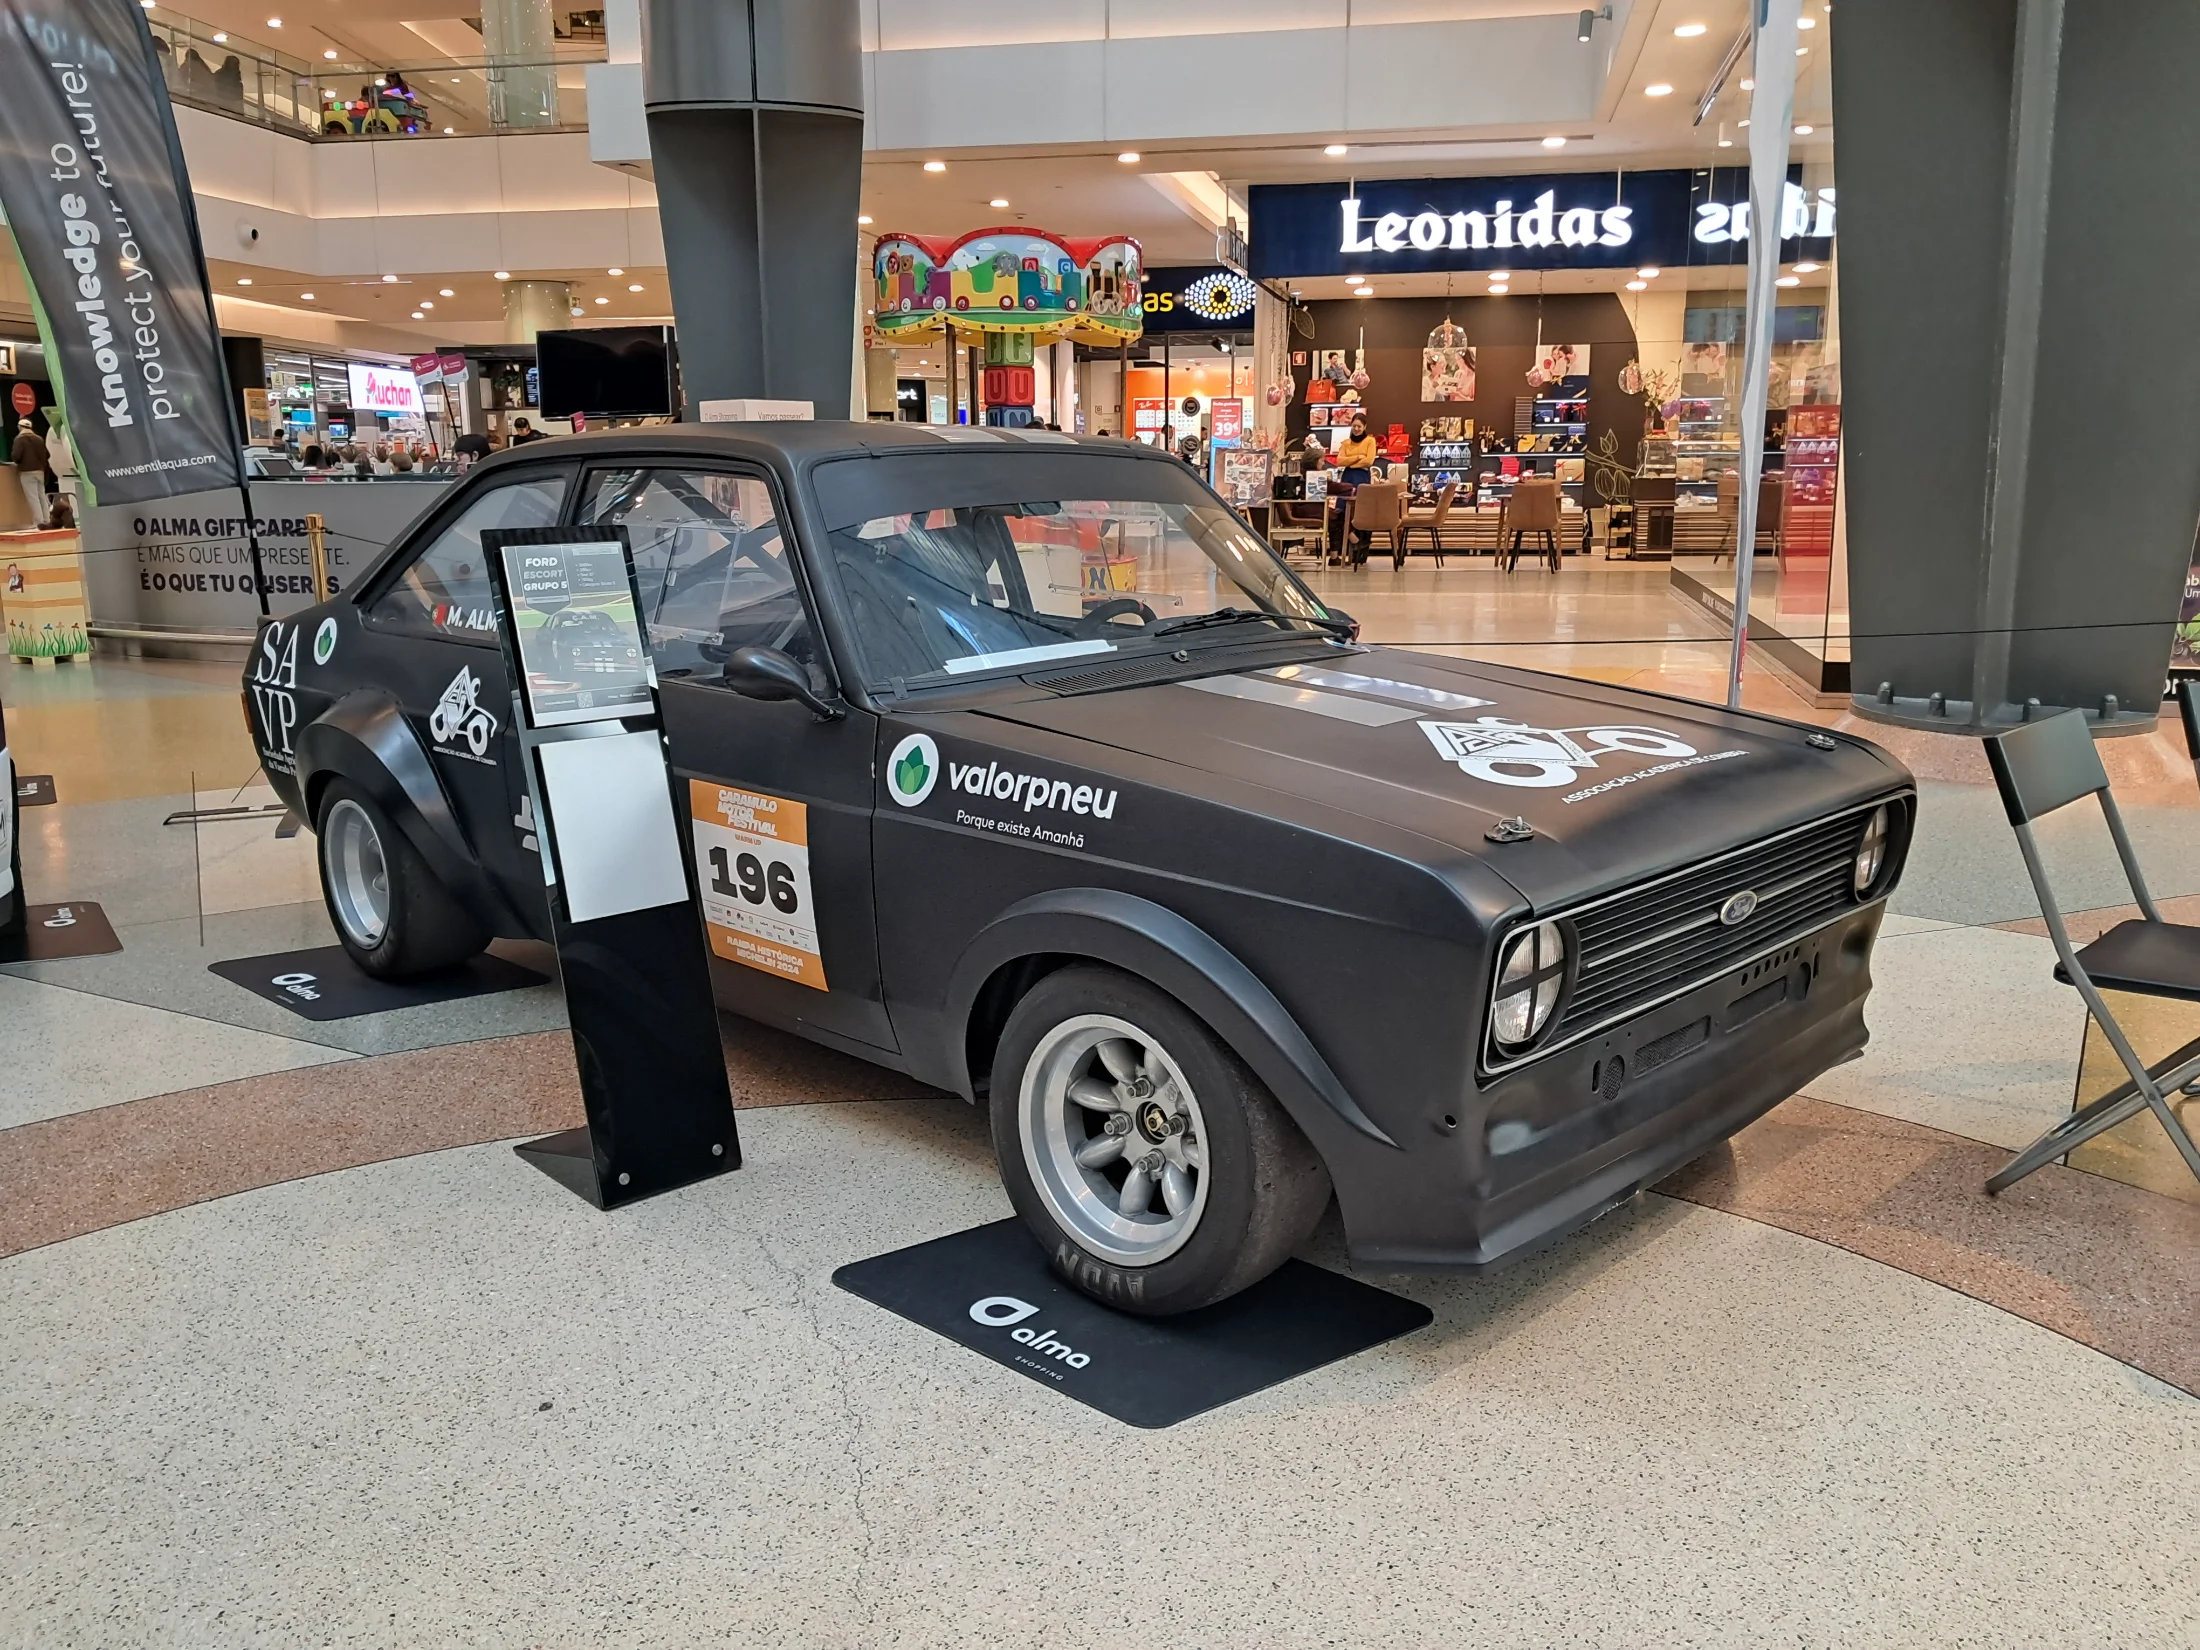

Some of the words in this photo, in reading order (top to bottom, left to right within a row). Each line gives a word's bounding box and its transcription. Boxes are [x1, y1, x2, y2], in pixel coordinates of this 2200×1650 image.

[51, 62, 113, 189] future!
[51, 143, 81, 181] to
[1340, 188, 1633, 253] Leonidas
[109, 200, 153, 282] your
[60, 193, 133, 428] Knowledge
[1143, 292, 1173, 312] as
[124, 292, 180, 420] protect
[366, 372, 412, 405] Auchan
[105, 453, 216, 479] www.ventilaqua.com
[134, 517, 147, 536] O
[150, 518, 202, 536] ALMA
[204, 518, 247, 537] GIFT
[253, 518, 308, 537] CARD
[137, 544, 145, 563] É
[149, 547, 185, 564] MAIS
[189, 547, 223, 564] QUE
[227, 548, 253, 564] UM
[260, 548, 349, 565] PRESETE.
[525, 556, 558, 568] FORD
[140, 568, 150, 591] É
[153, 573, 166, 592] O
[169, 574, 208, 593] QUE
[209, 574, 234, 593] TU
[238, 575, 344, 595] QISERS.
[523, 569, 563, 580] ESCORT
[523, 581, 560, 592] GRUPO
[561, 580, 567, 589] 5
[446, 605, 463, 628] M.
[465, 608, 500, 633] ALM
[254, 620, 299, 690] SA
[252, 684, 297, 754] VP
[718, 789, 778, 813] CARAMULO
[949, 761, 1117, 820] valorpneu
[1561, 775, 1637, 805] ASSOCIAÇÃO
[717, 800, 754, 821] MOTOR
[727, 814, 778, 837] FESTIVAL
[956, 809, 995, 830] Porque
[997, 820, 1031, 837] existe
[1032, 825, 1084, 848] Amanhã
[708, 846, 798, 915] 196
[726, 935, 756, 952] RAMPA
[757, 946, 804, 967] HISTÓRICA
[776, 961, 800, 975] 2024
[1010, 1329, 1091, 1370] alma
[1014, 1355, 1064, 1382] SHOPPING
